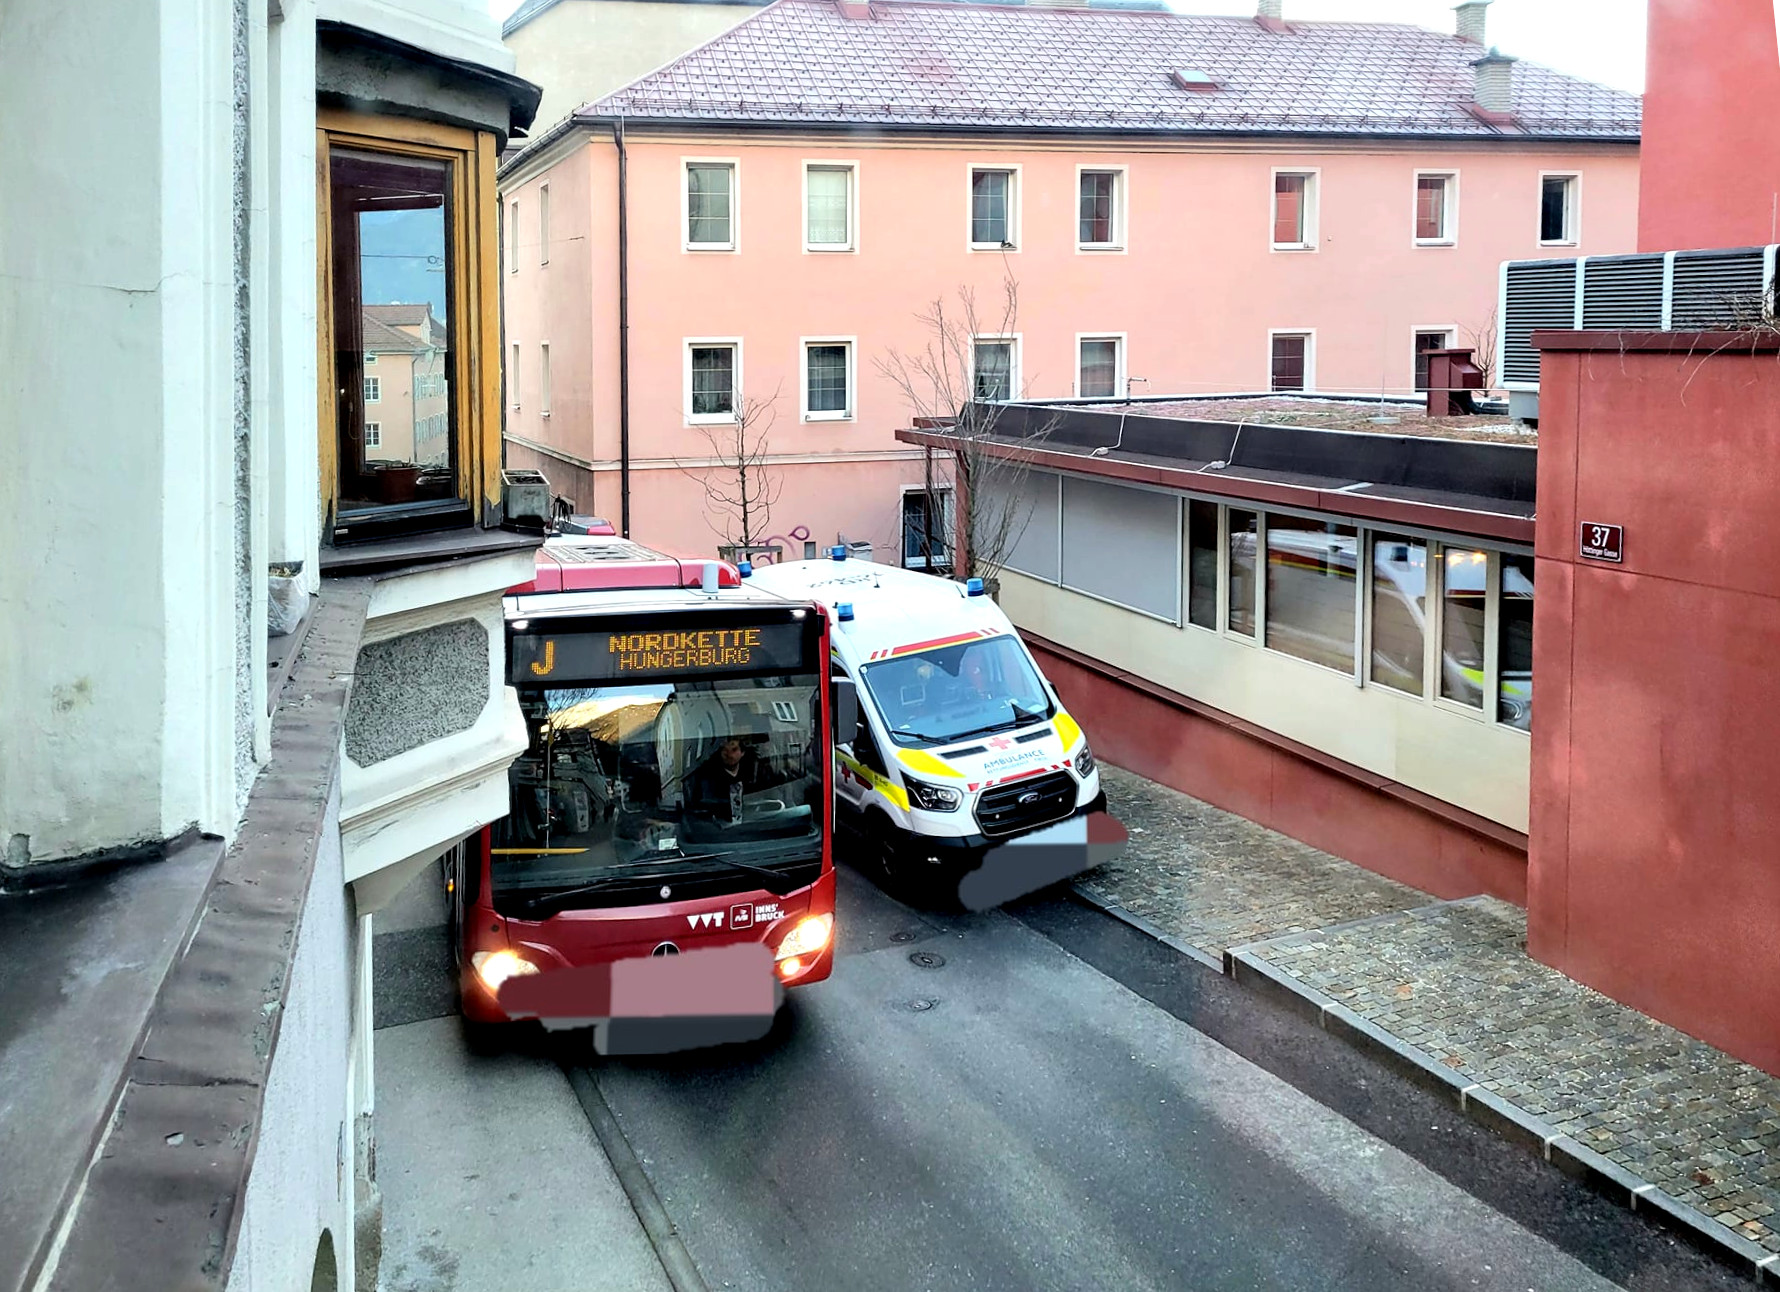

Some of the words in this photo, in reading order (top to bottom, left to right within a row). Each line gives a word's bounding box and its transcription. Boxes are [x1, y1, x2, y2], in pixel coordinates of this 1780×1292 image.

[1591, 526, 1610, 547] 37
[609, 629, 761, 653] NORDKETTE
[531, 640, 555, 676] J
[620, 648, 750, 670] HUNGERBURG
[984, 749, 1045, 769] AMBULANCE
[687, 912, 724, 930] VVT
[756, 910, 784, 922] BRUCK
